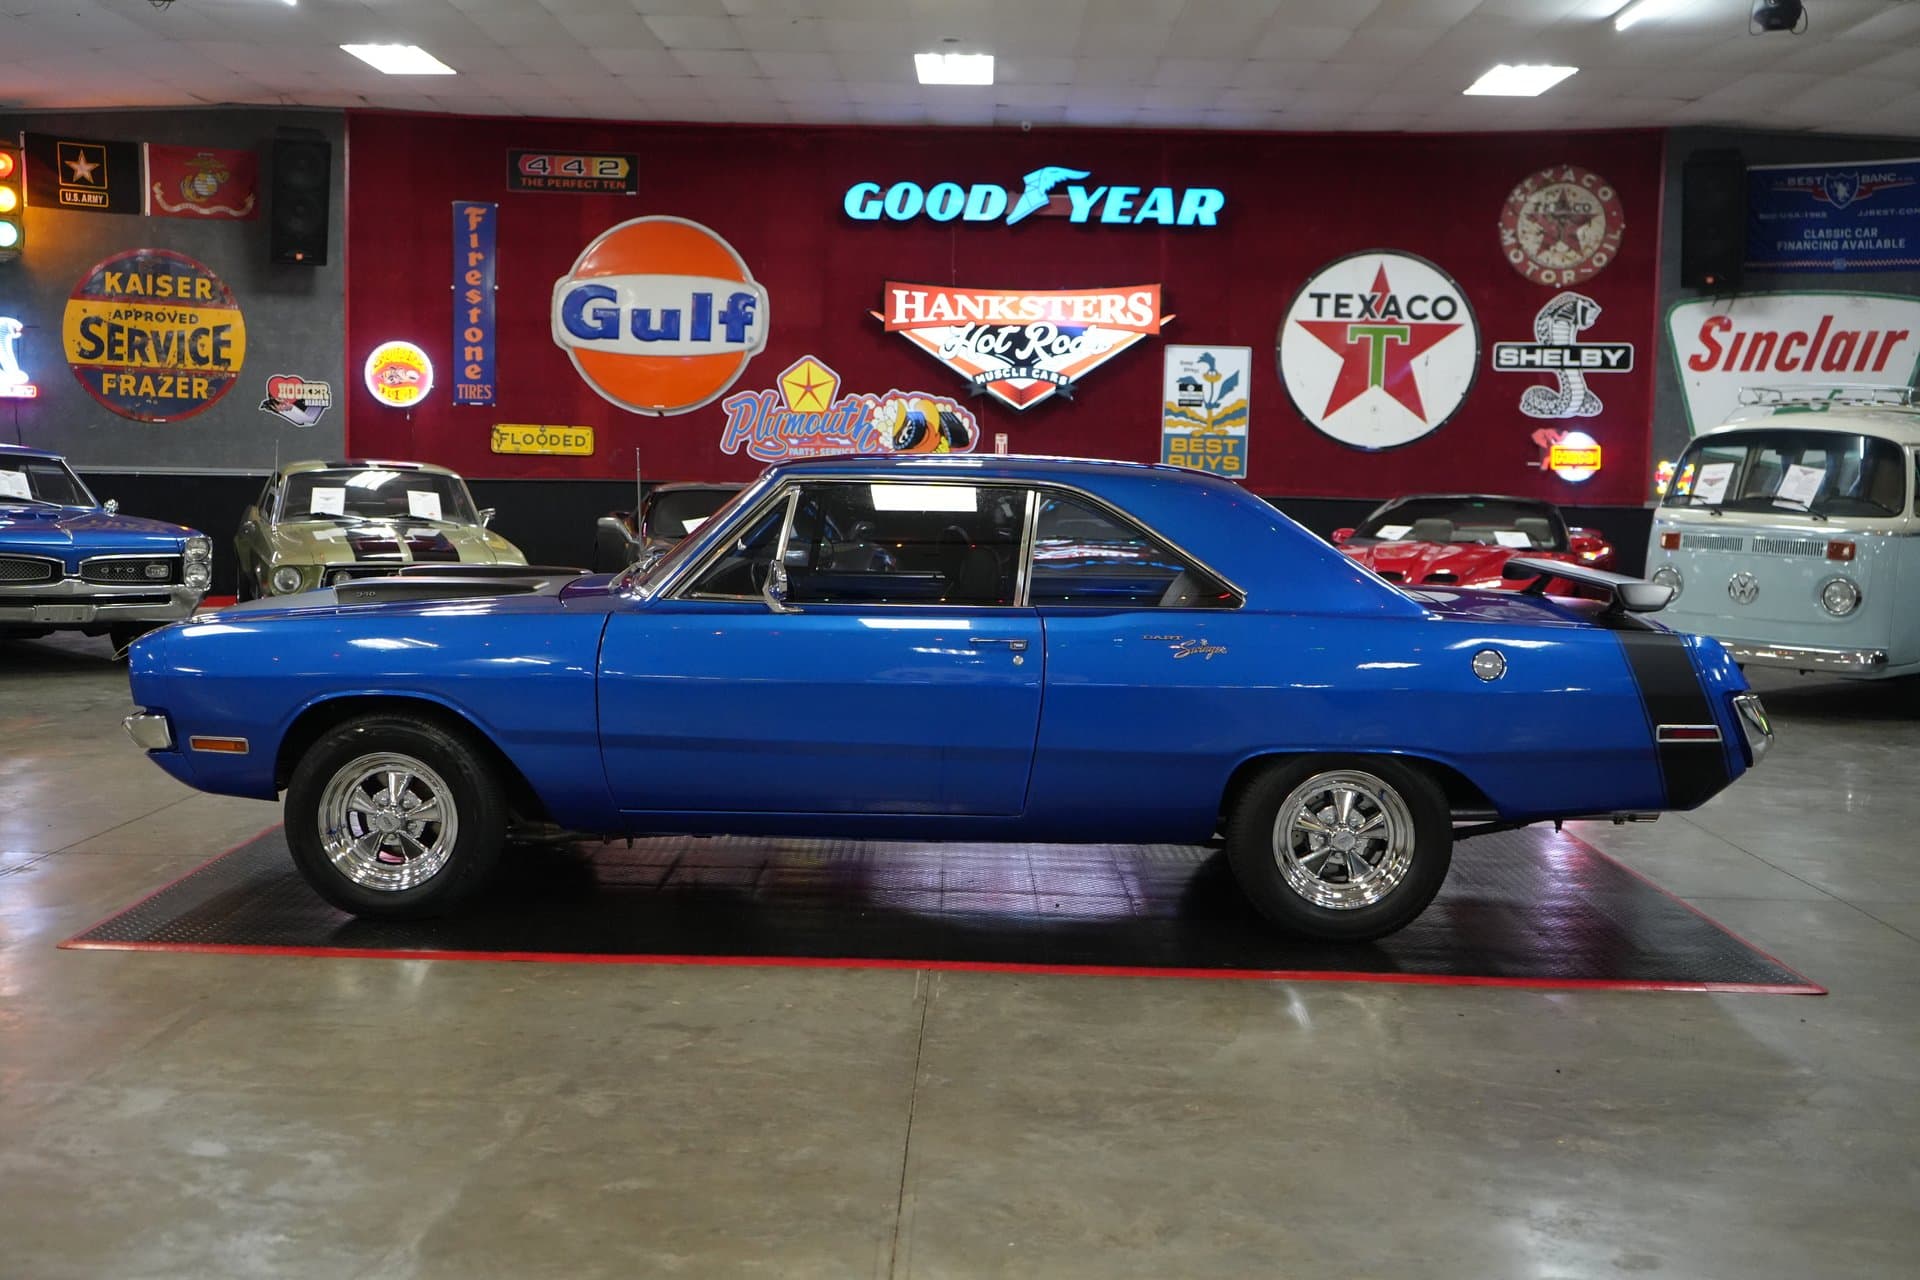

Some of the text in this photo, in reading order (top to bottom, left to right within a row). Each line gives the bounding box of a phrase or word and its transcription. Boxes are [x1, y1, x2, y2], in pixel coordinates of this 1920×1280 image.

[520, 177, 627, 190] THE PERFECT TEN
[1787, 175, 1824, 186] BEST
[1861, 173, 1896, 183] BANC
[65, 193, 104, 204] U.S. ARMY
[844, 182, 1225, 225] GOOD YEAR
[1533, 202, 1593, 214] TECO
[1804, 228, 1878, 239] CLASSIC CAR
[1777, 238, 1906, 250] FINANCING AVAILABLE
[1503, 228, 1623, 285] MOTOR OIL
[104, 271, 213, 299] KAISER
[464, 206, 486, 380] Firestone
[112, 308, 199, 325] APPROVED
[562, 284, 757, 343] Gulf
[891, 289, 1155, 325] HANKSTERS
[1309, 292, 1458, 321] TEXACO
[78, 316, 232, 367] SERVICE
[938, 321, 1020, 360] Hot
[1688, 315, 1910, 372] Sinclair
[1347, 324, 1411, 388] T
[1500, 348, 1625, 367] SHELBY
[976, 366, 1069, 386] MUSCLE CARS
[102, 373, 210, 400] FRAZER
[278, 383, 329, 400] HOOKER
[457, 384, 492, 399] TIRES
[729, 397, 877, 455] Plymouth
[500, 430, 587, 448] FLOODED
[1170, 437, 1239, 454] BEST
[1168, 455, 1240, 471] BUYS
